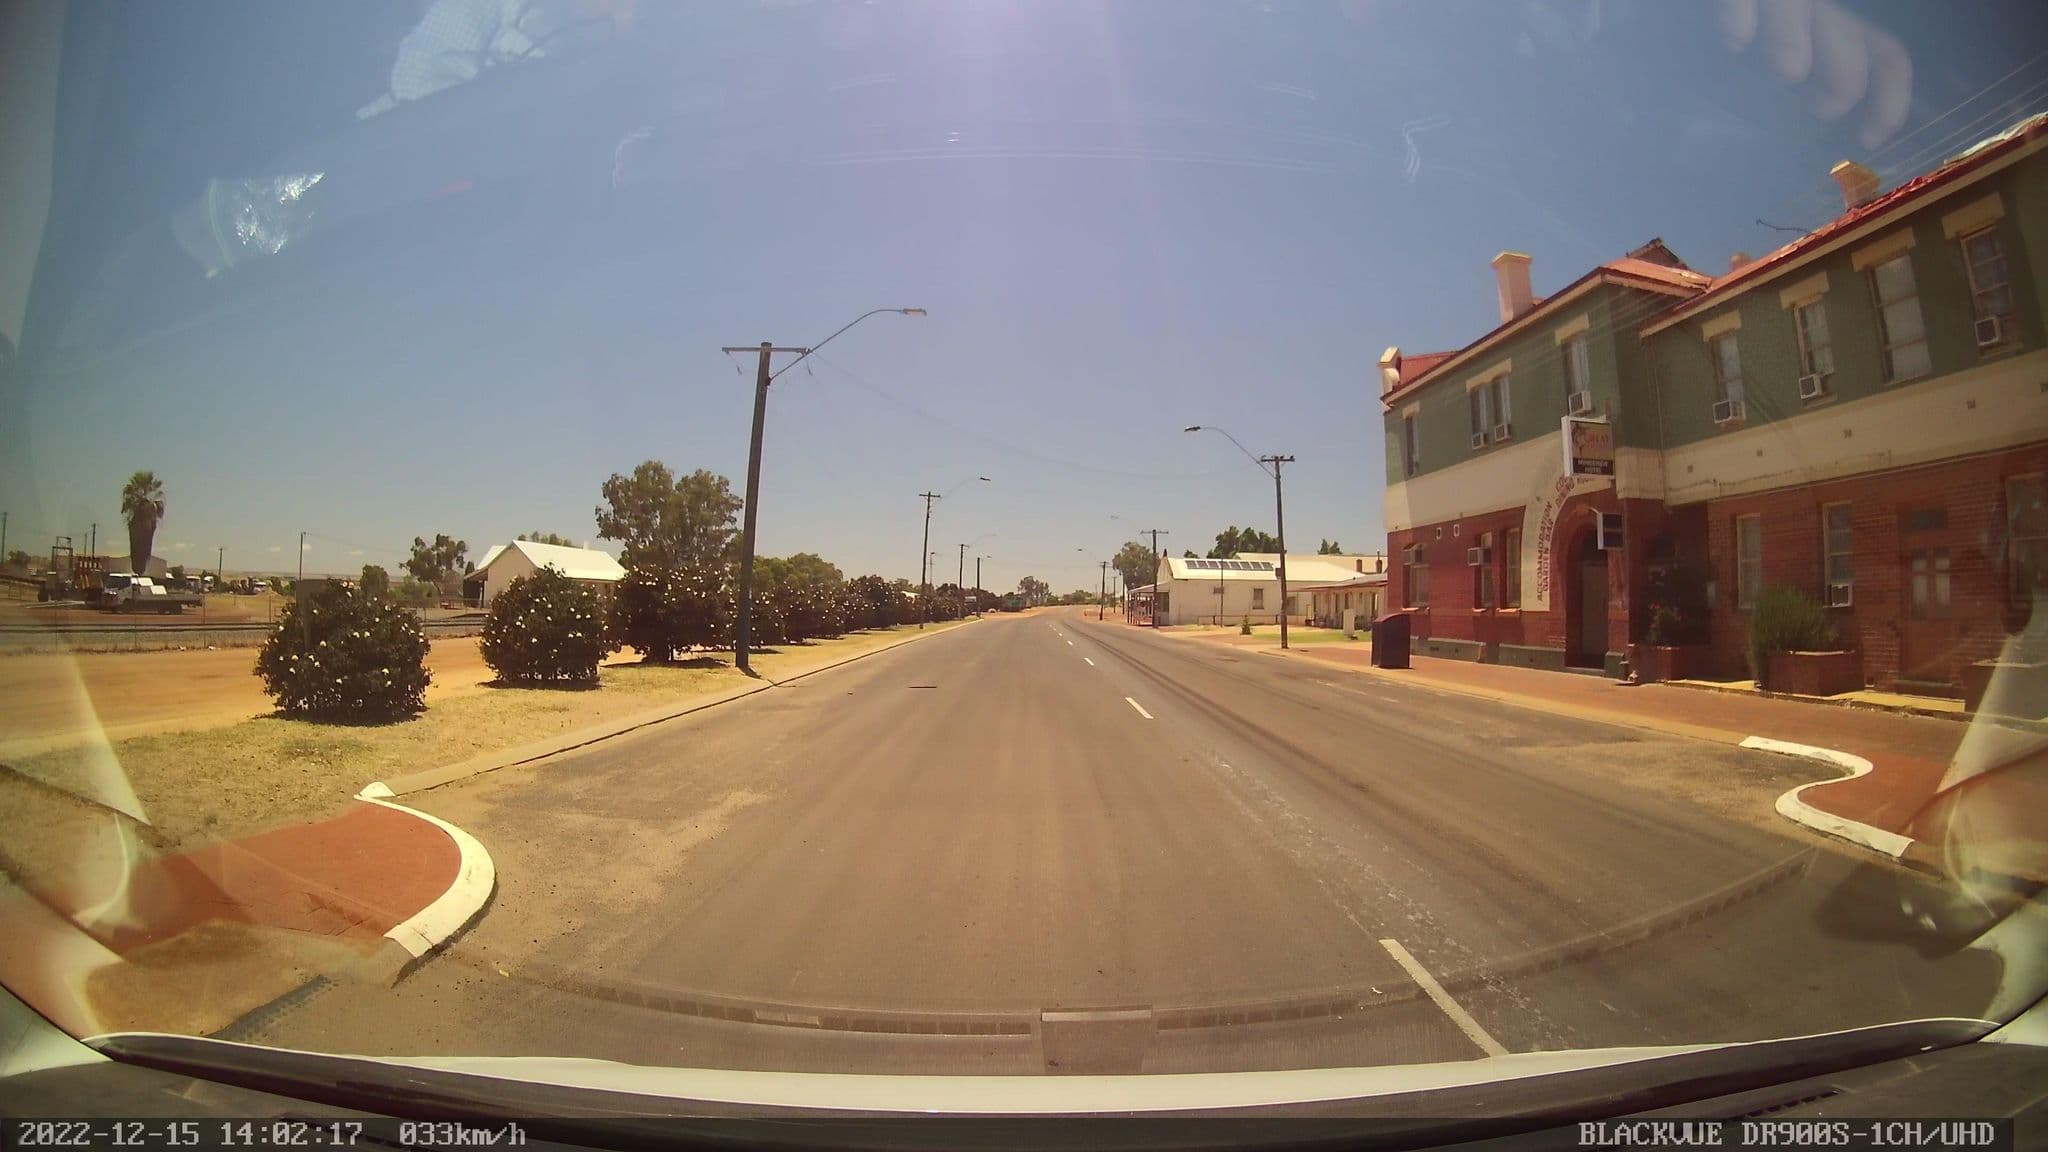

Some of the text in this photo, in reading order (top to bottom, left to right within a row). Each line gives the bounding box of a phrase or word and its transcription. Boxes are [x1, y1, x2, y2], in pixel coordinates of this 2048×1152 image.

[1536, 501, 1552, 601] ACCOMMODATION
[1542, 518, 1554, 592] GARDEN BAR
